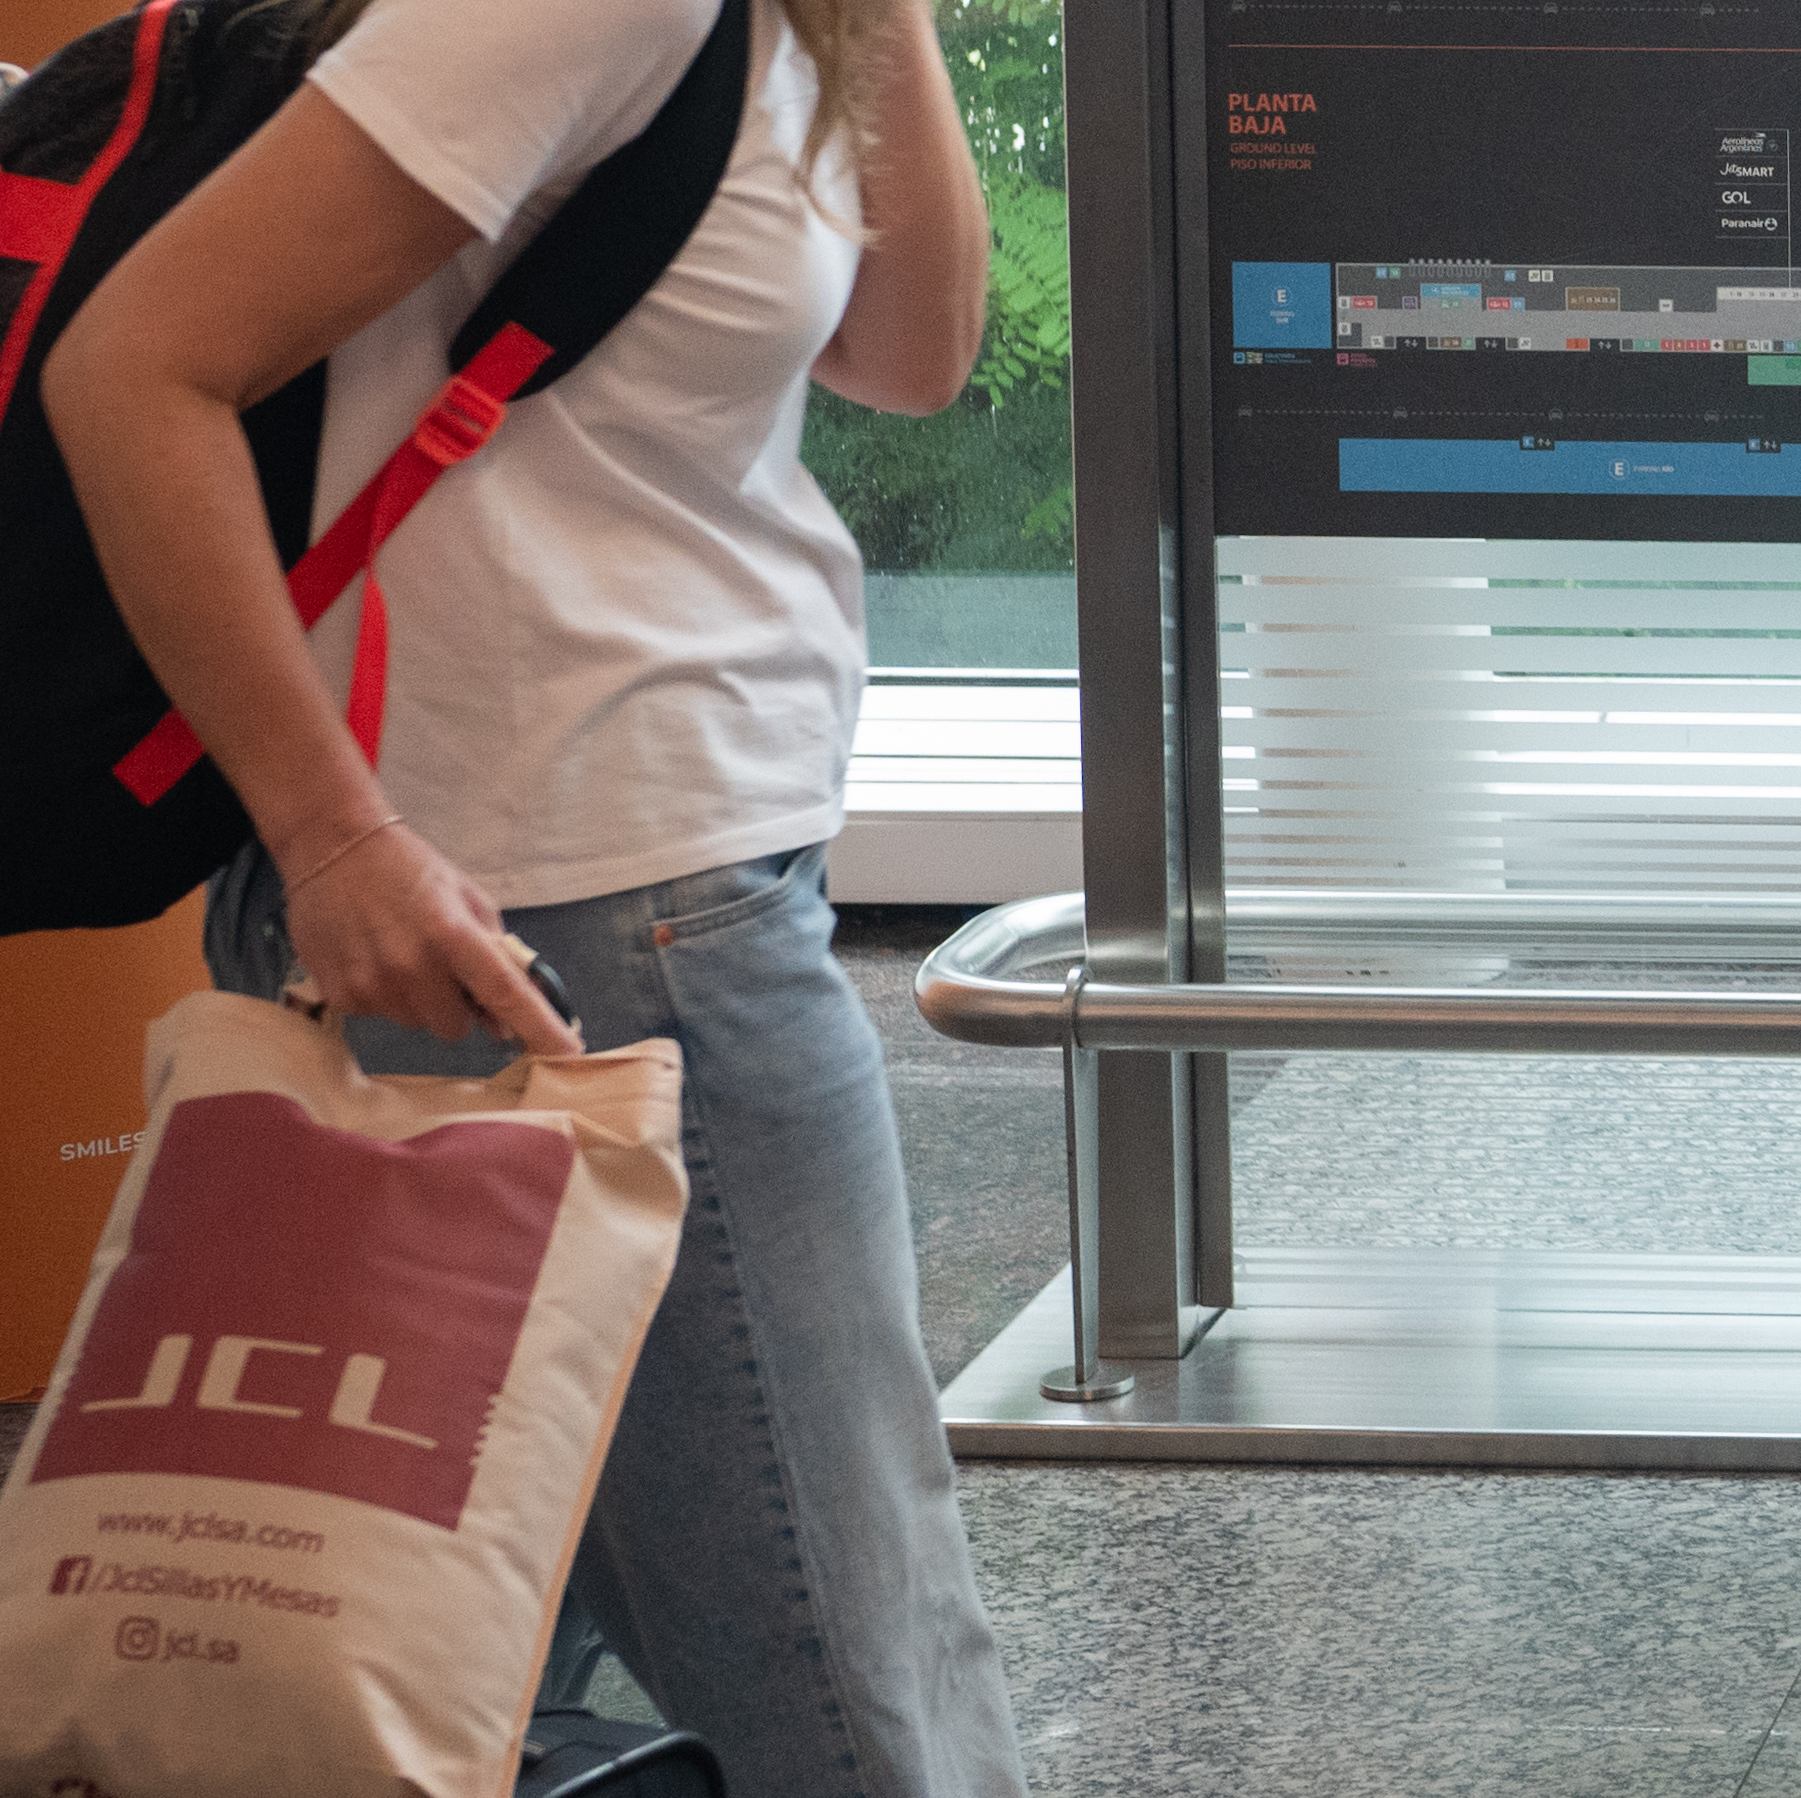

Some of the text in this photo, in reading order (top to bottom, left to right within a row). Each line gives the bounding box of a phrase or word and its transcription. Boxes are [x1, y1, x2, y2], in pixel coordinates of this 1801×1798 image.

[1228, 93, 1317, 113] PLANTA
[1228, 115, 1287, 135] BAJA
[1229, 142, 1317, 155] GROUND LEVEL
[1230, 158, 1258, 170] PISO
[1721, 190, 1751, 205] GOL
[1721, 218, 1764, 228] Paranair
[78, 1334, 438, 1449] JCL
